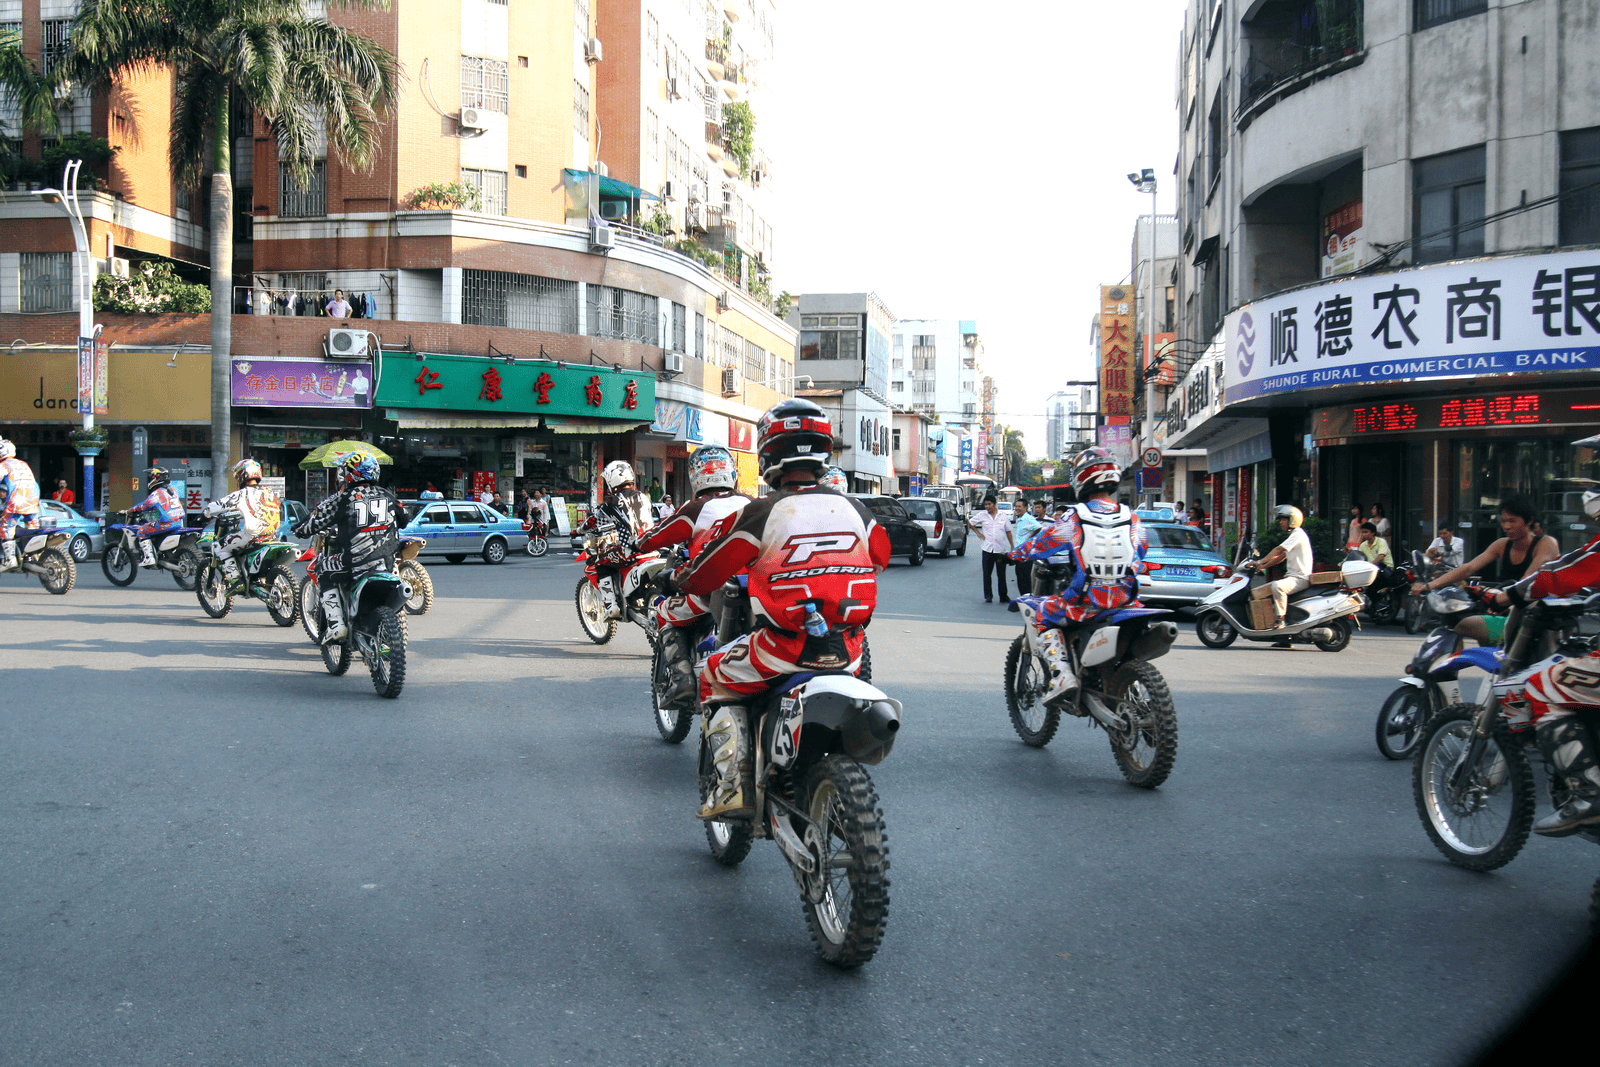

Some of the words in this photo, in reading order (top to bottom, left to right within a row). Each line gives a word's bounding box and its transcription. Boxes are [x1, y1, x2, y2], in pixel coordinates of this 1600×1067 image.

[1268, 266, 1600, 368] 顺德农商银
[1105, 318, 1129, 415] 大众眼镜
[1262, 373, 1308, 391] SHUNDE
[1311, 366, 1362, 382] RURAL
[1369, 355, 1504, 377] COMMERCIAL
[1515, 351, 1588, 367] BANK
[245, 374, 335, 391] 存金日杂店
[415, 365, 639, 411] 仁康堂药店
[1146, 451, 1159, 463] 30
[354, 497, 388, 528] 14
[629, 569, 640, 588] 19
[768, 566, 875, 584] PROGRIP
